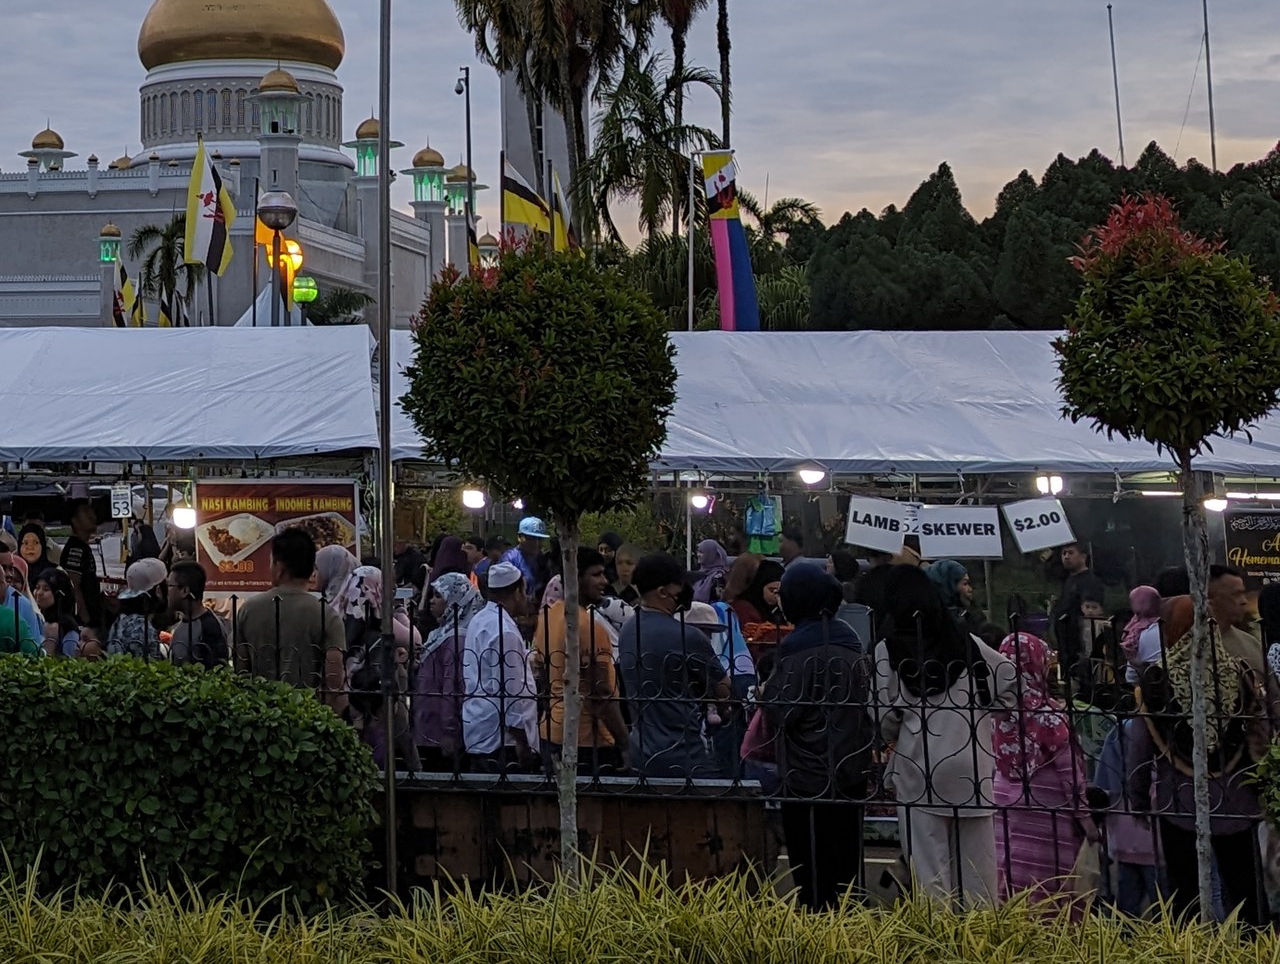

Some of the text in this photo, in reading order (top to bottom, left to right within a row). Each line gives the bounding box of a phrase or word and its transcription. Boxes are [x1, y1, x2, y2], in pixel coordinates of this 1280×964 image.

[113, 501, 130, 516] 53
[201, 498, 269, 511] NASI KAMBING
[275, 497, 352, 511] INDOMIE KAMBING
[852, 511, 900, 532] LAMB
[1013, 511, 1061, 532] $2.00
[922, 523, 996, 536] SKEWER
